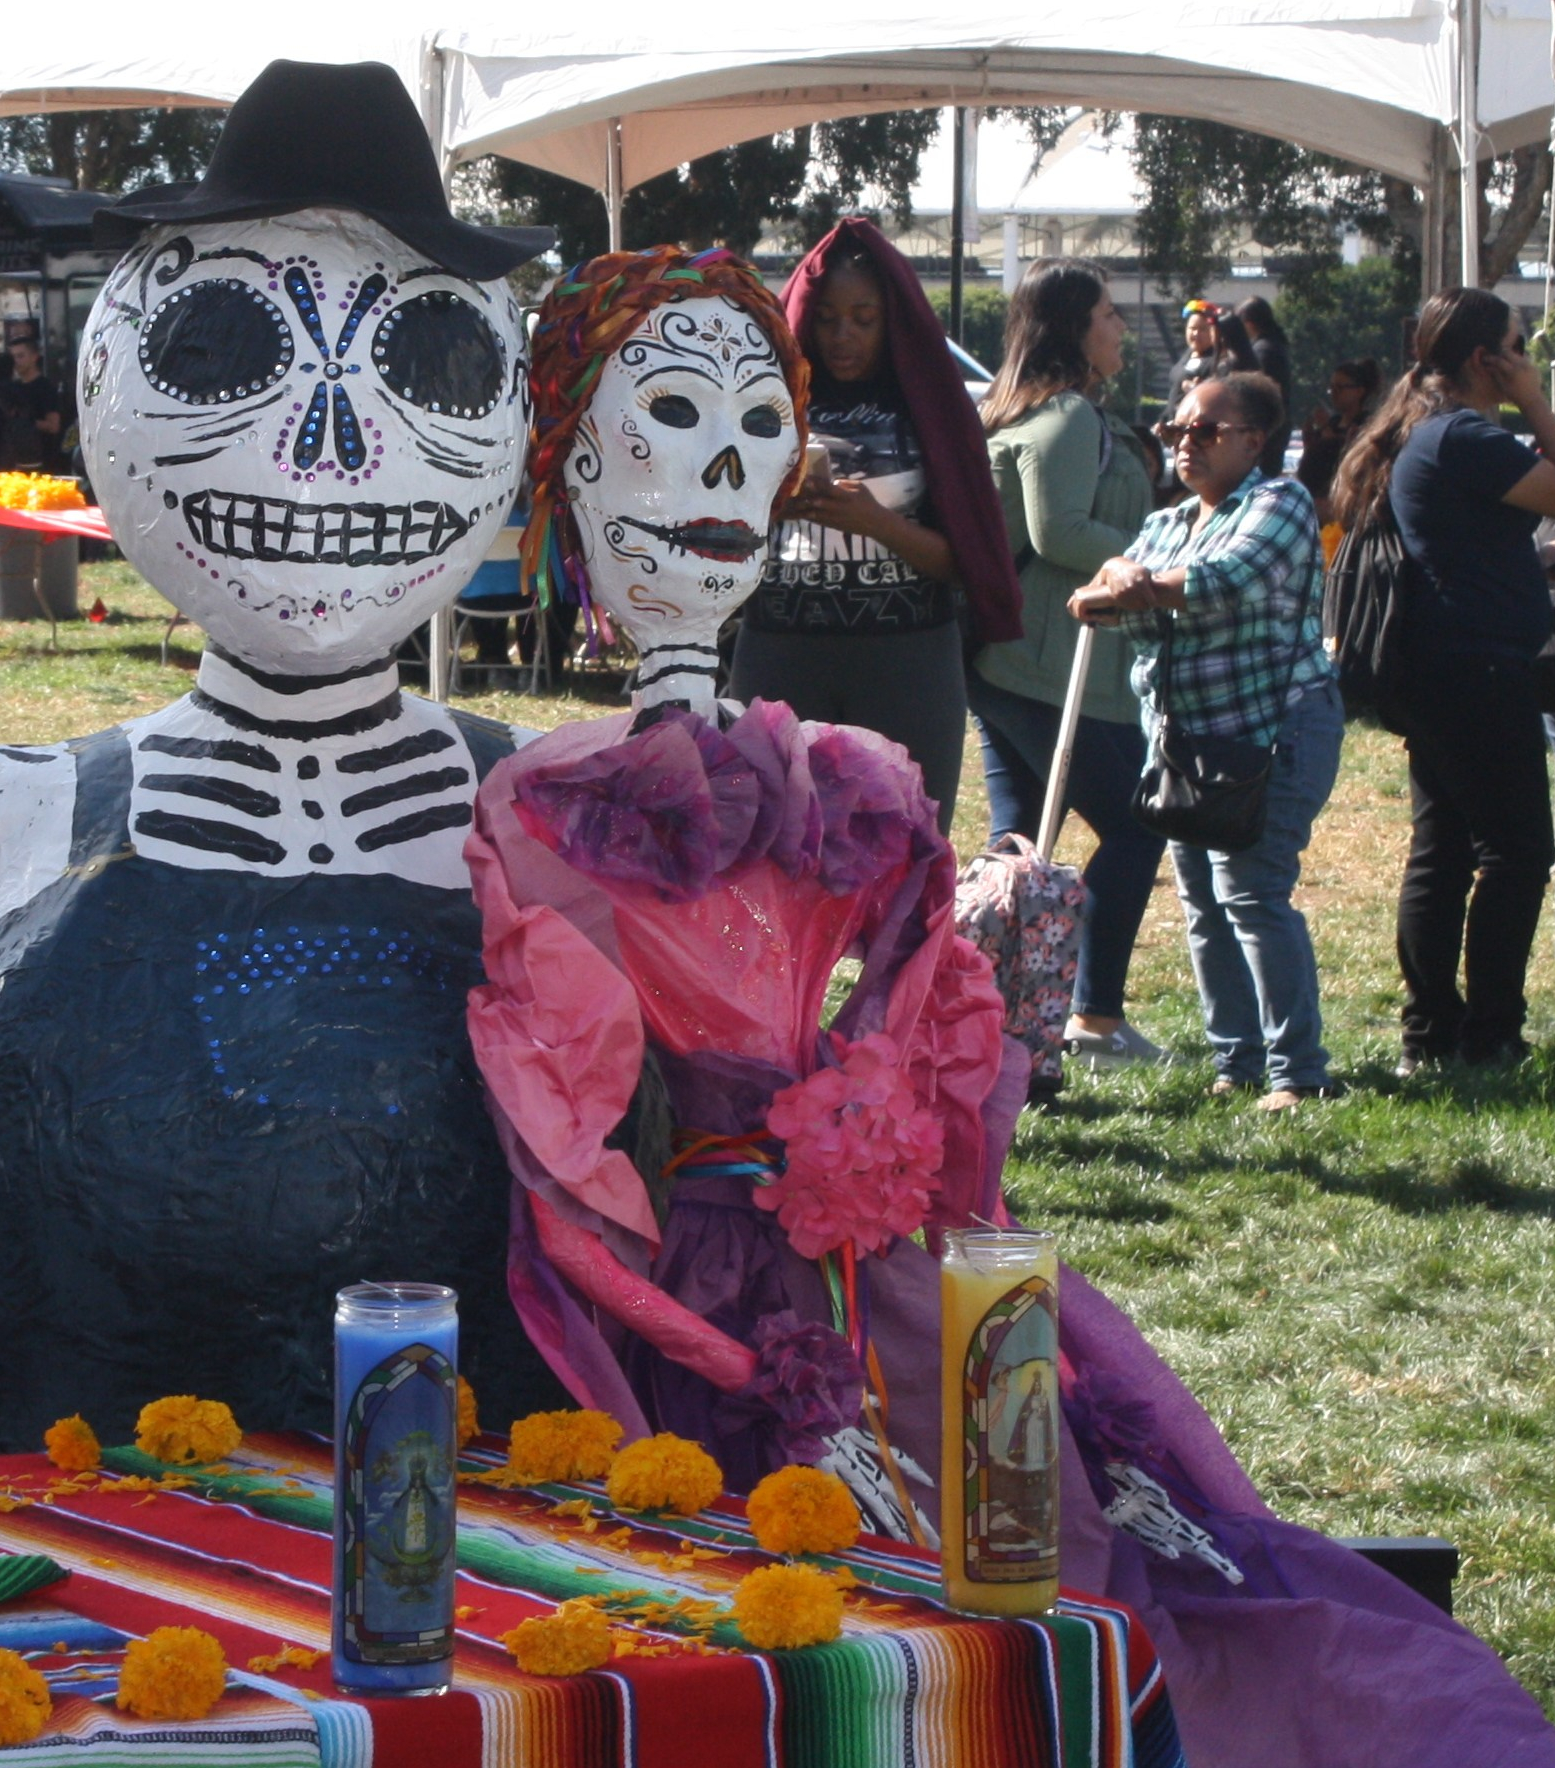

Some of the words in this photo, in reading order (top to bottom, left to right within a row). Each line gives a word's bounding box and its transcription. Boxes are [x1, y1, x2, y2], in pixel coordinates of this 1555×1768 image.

[763, 561, 845, 590] THEY
[857, 559, 918, 586] CAL
[759, 580, 936, 627] EAZY
